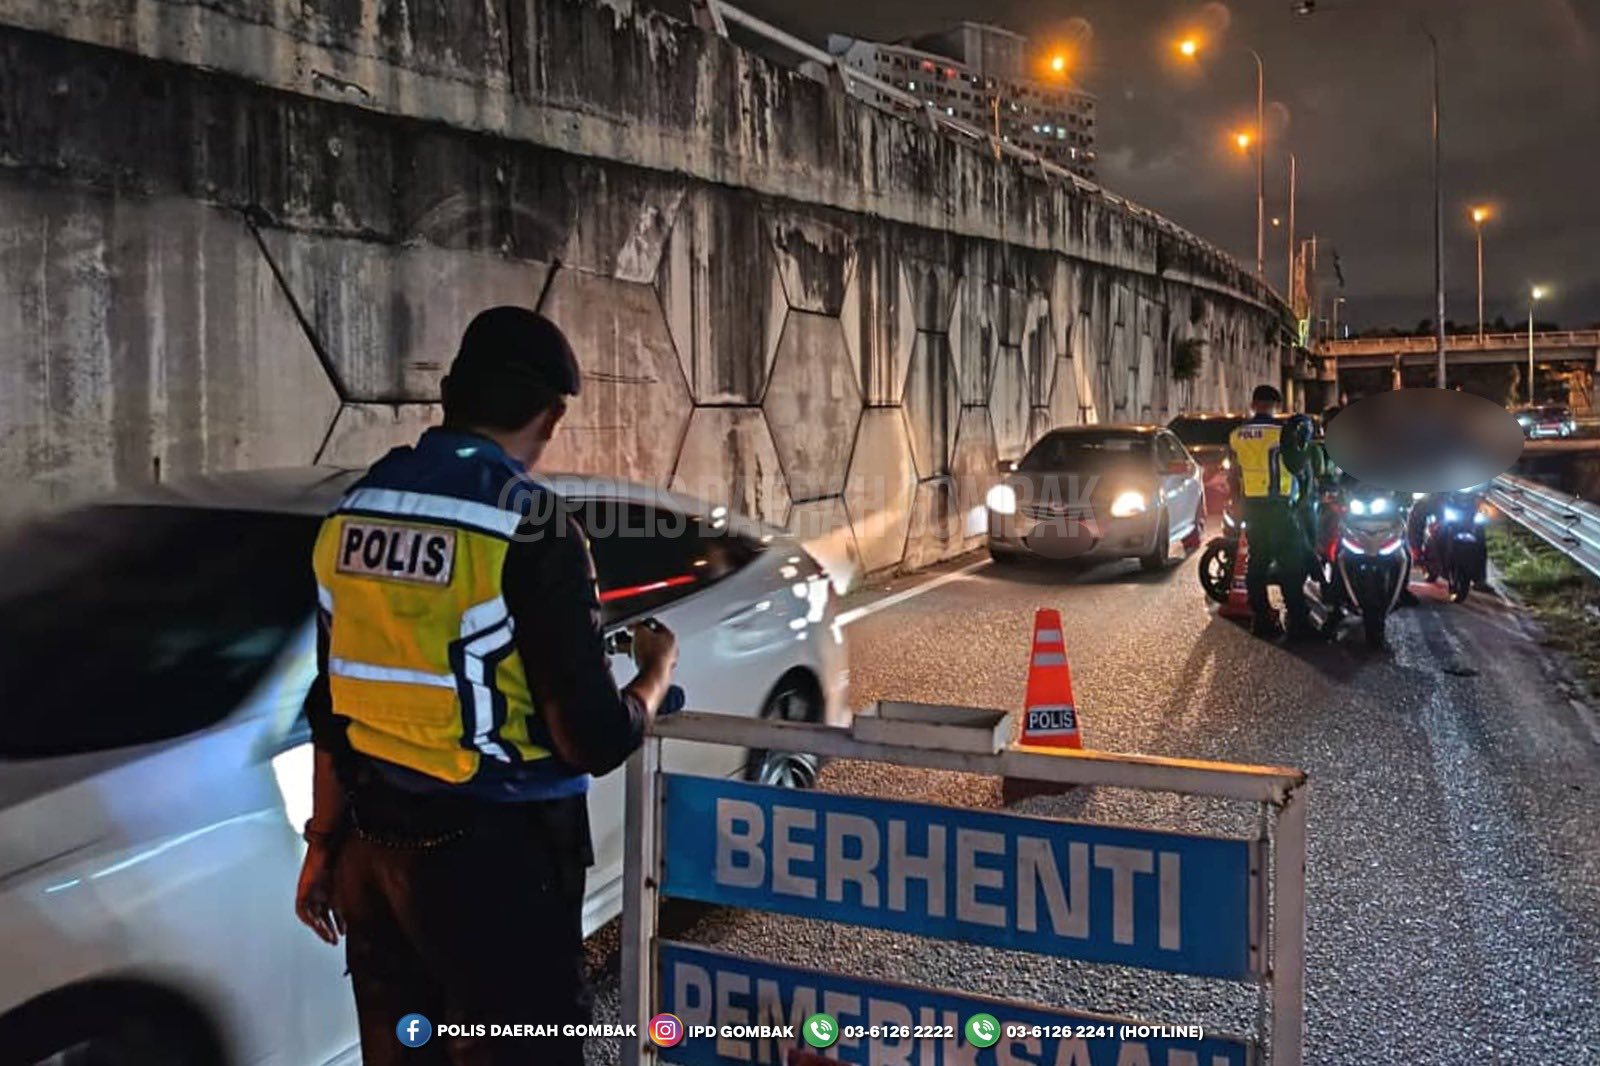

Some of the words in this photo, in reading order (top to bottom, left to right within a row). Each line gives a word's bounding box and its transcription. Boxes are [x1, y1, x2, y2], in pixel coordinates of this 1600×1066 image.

[342, 527, 446, 577] POLIS
[1029, 711, 1073, 729] POLIS
[715, 797, 1182, 952] BERHENTI
[674, 961, 1231, 1066] PEMERIKS
